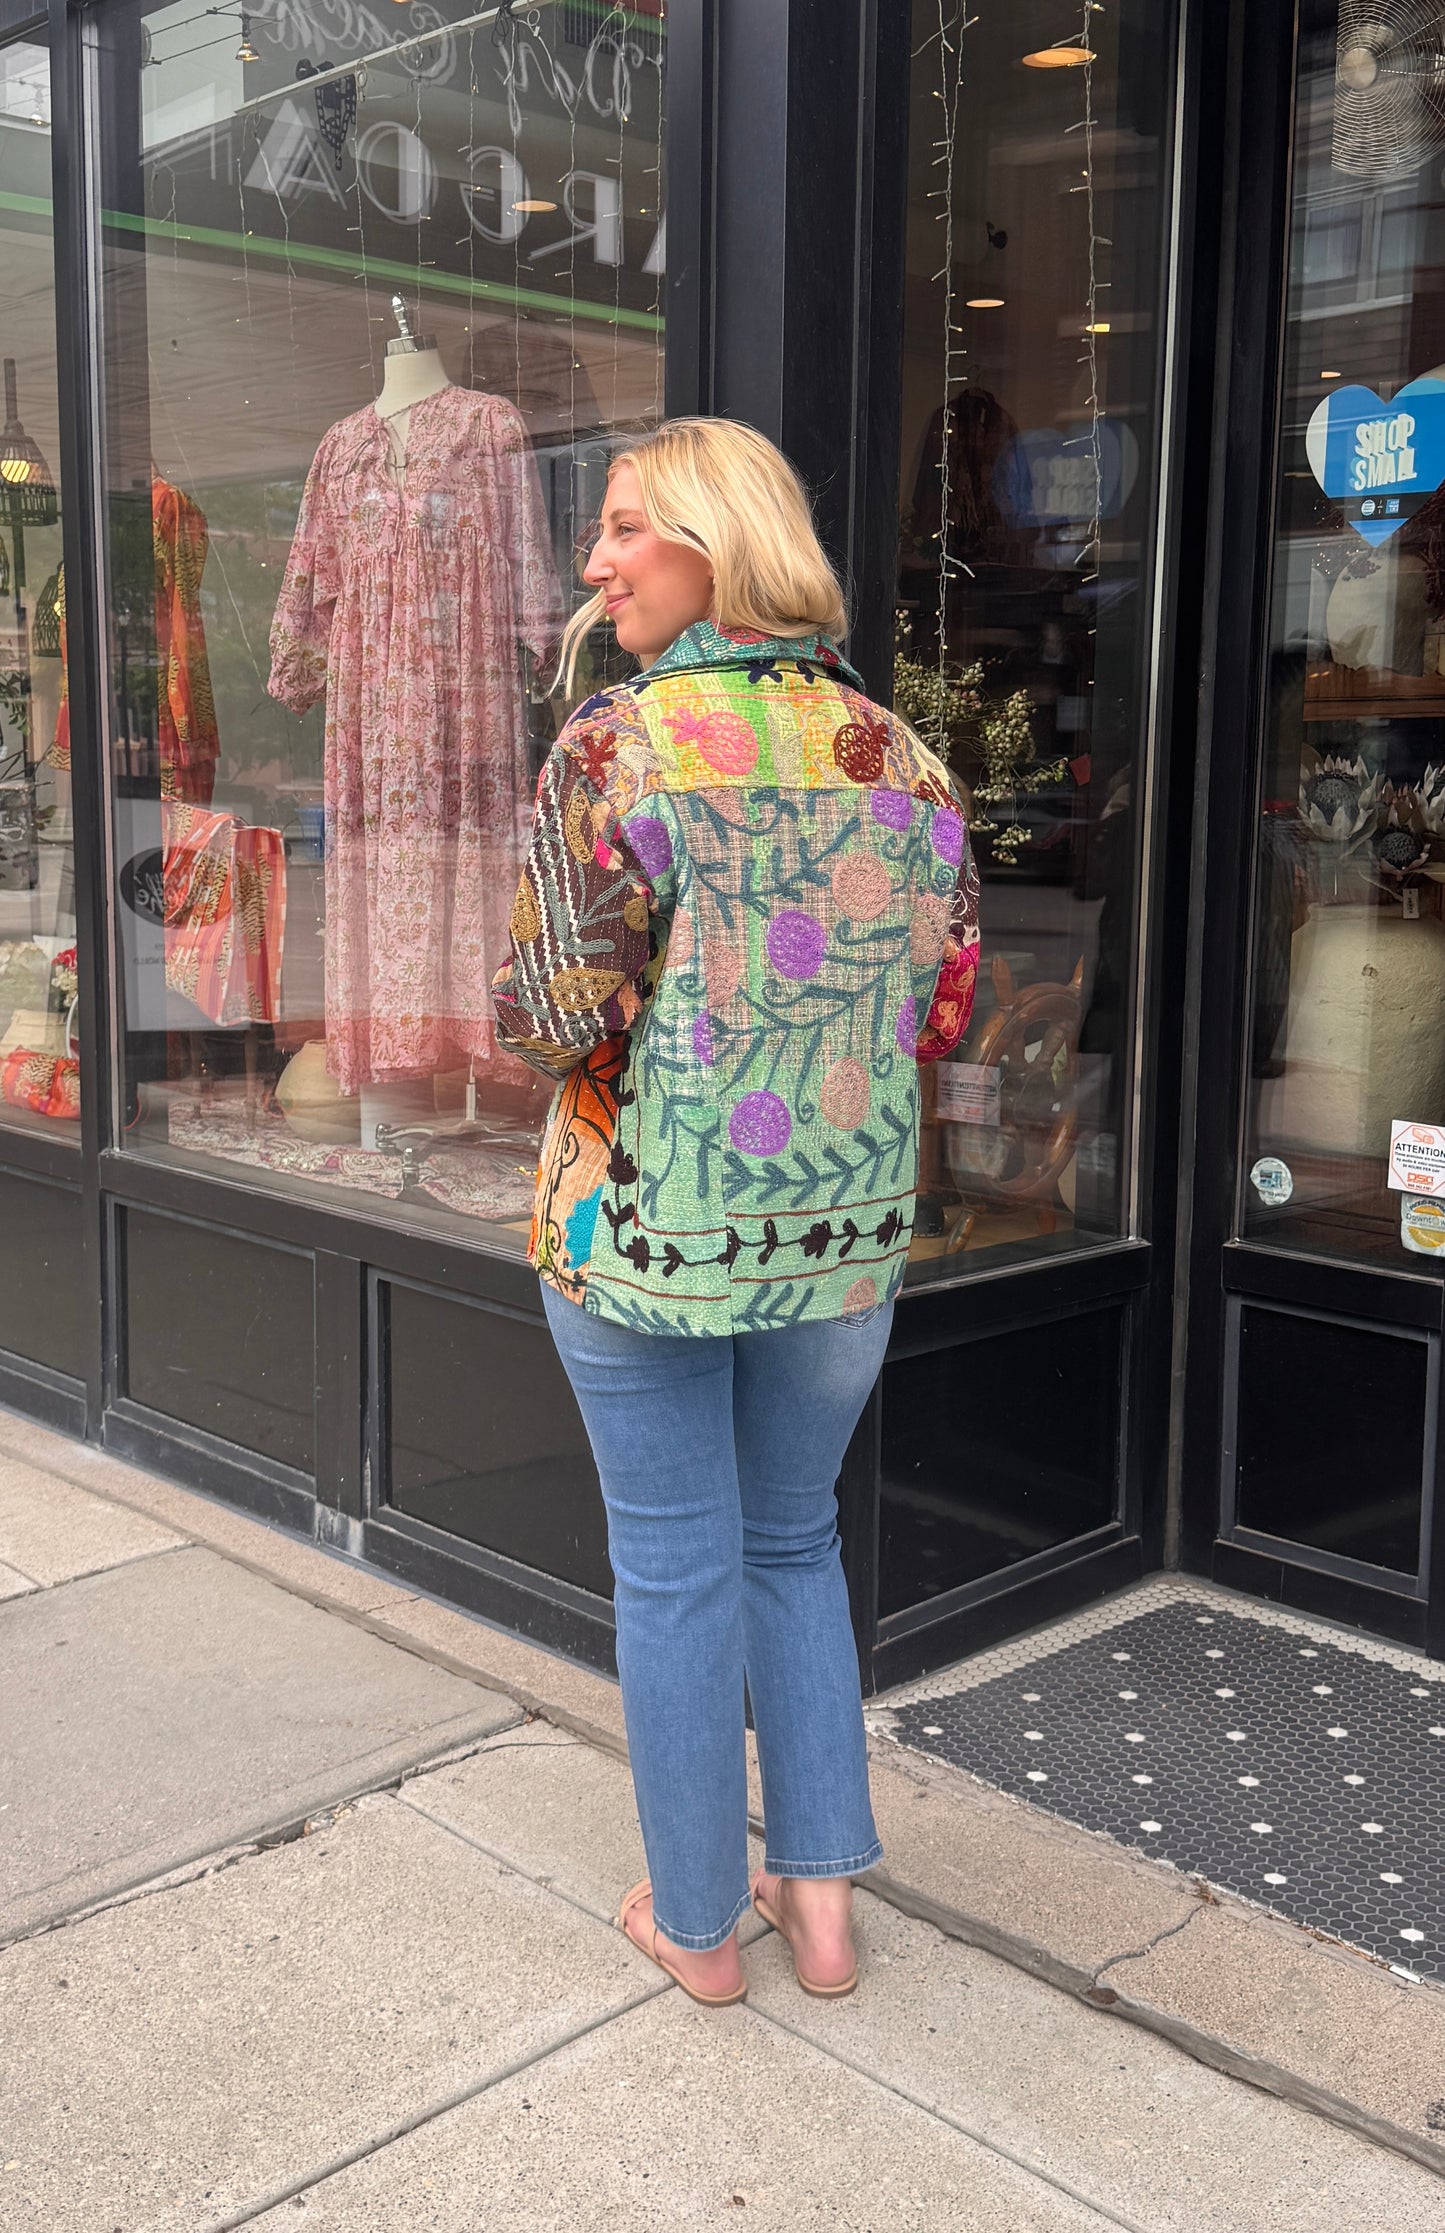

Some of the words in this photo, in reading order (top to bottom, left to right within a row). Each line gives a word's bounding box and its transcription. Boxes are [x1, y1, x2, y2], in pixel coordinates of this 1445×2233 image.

[1355, 413, 1415, 458] SHOP
[1353, 448, 1417, 491] SMALL
[1395, 1142, 1445, 1159] ATTENTION
